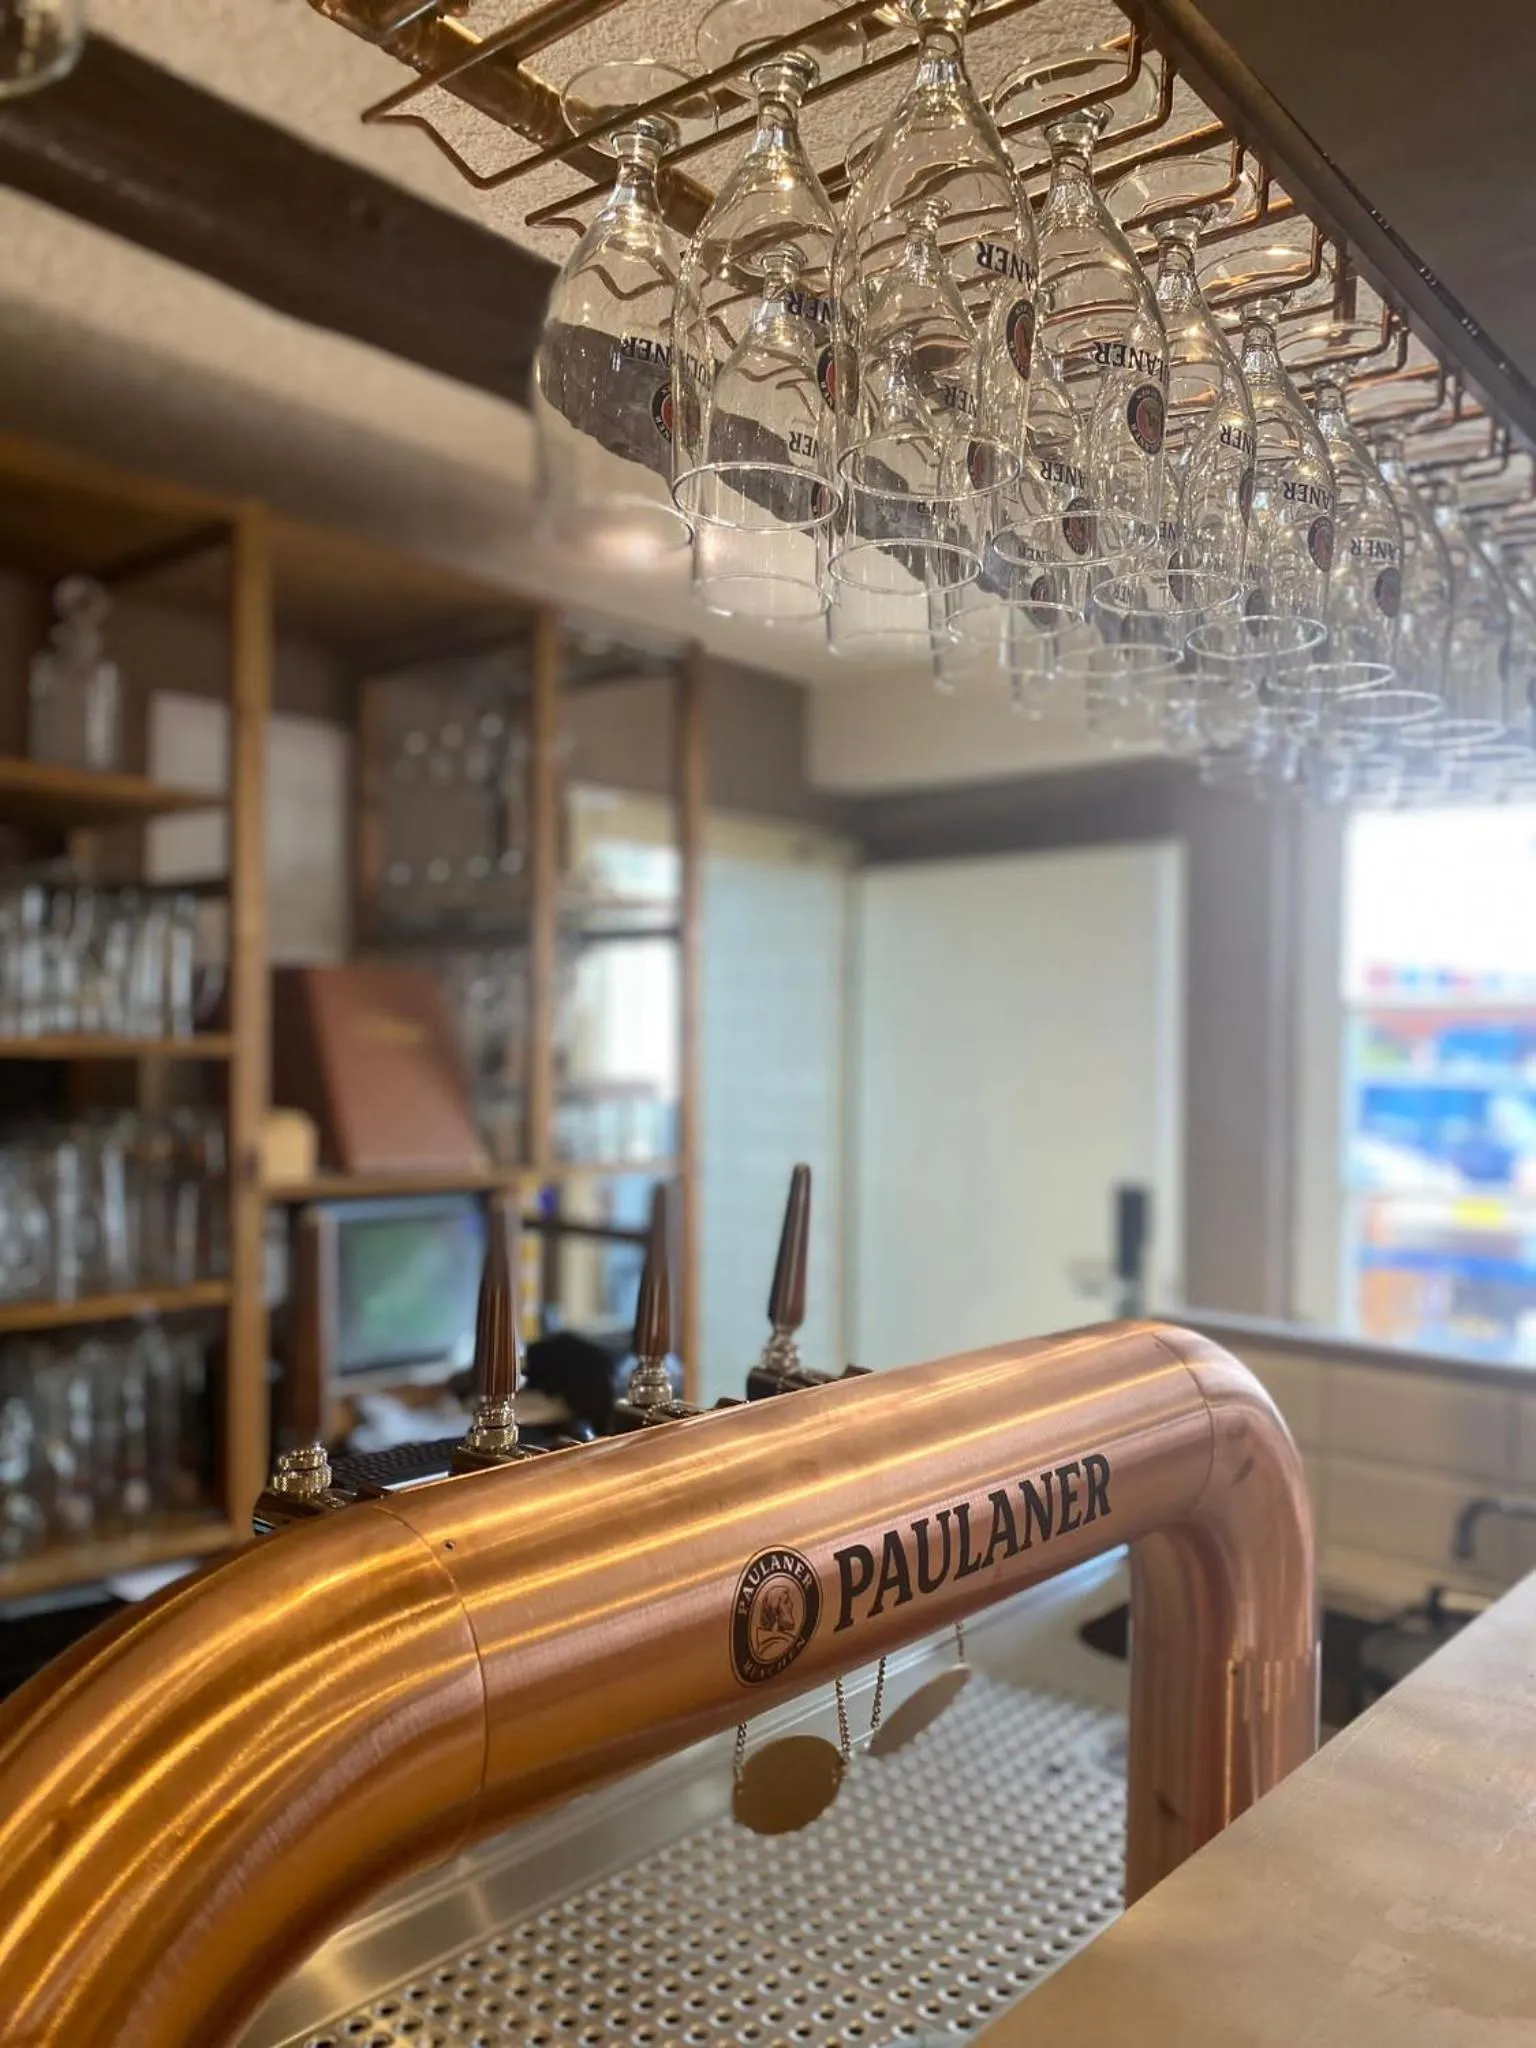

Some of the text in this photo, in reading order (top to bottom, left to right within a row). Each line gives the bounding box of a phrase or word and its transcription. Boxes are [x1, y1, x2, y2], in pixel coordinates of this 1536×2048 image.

[977, 241, 1038, 292] ANER
[1040, 460, 1086, 490] ANER
[833, 1453, 1112, 1633] PAULANER
[738, 1555, 813, 1616] PAULANER
